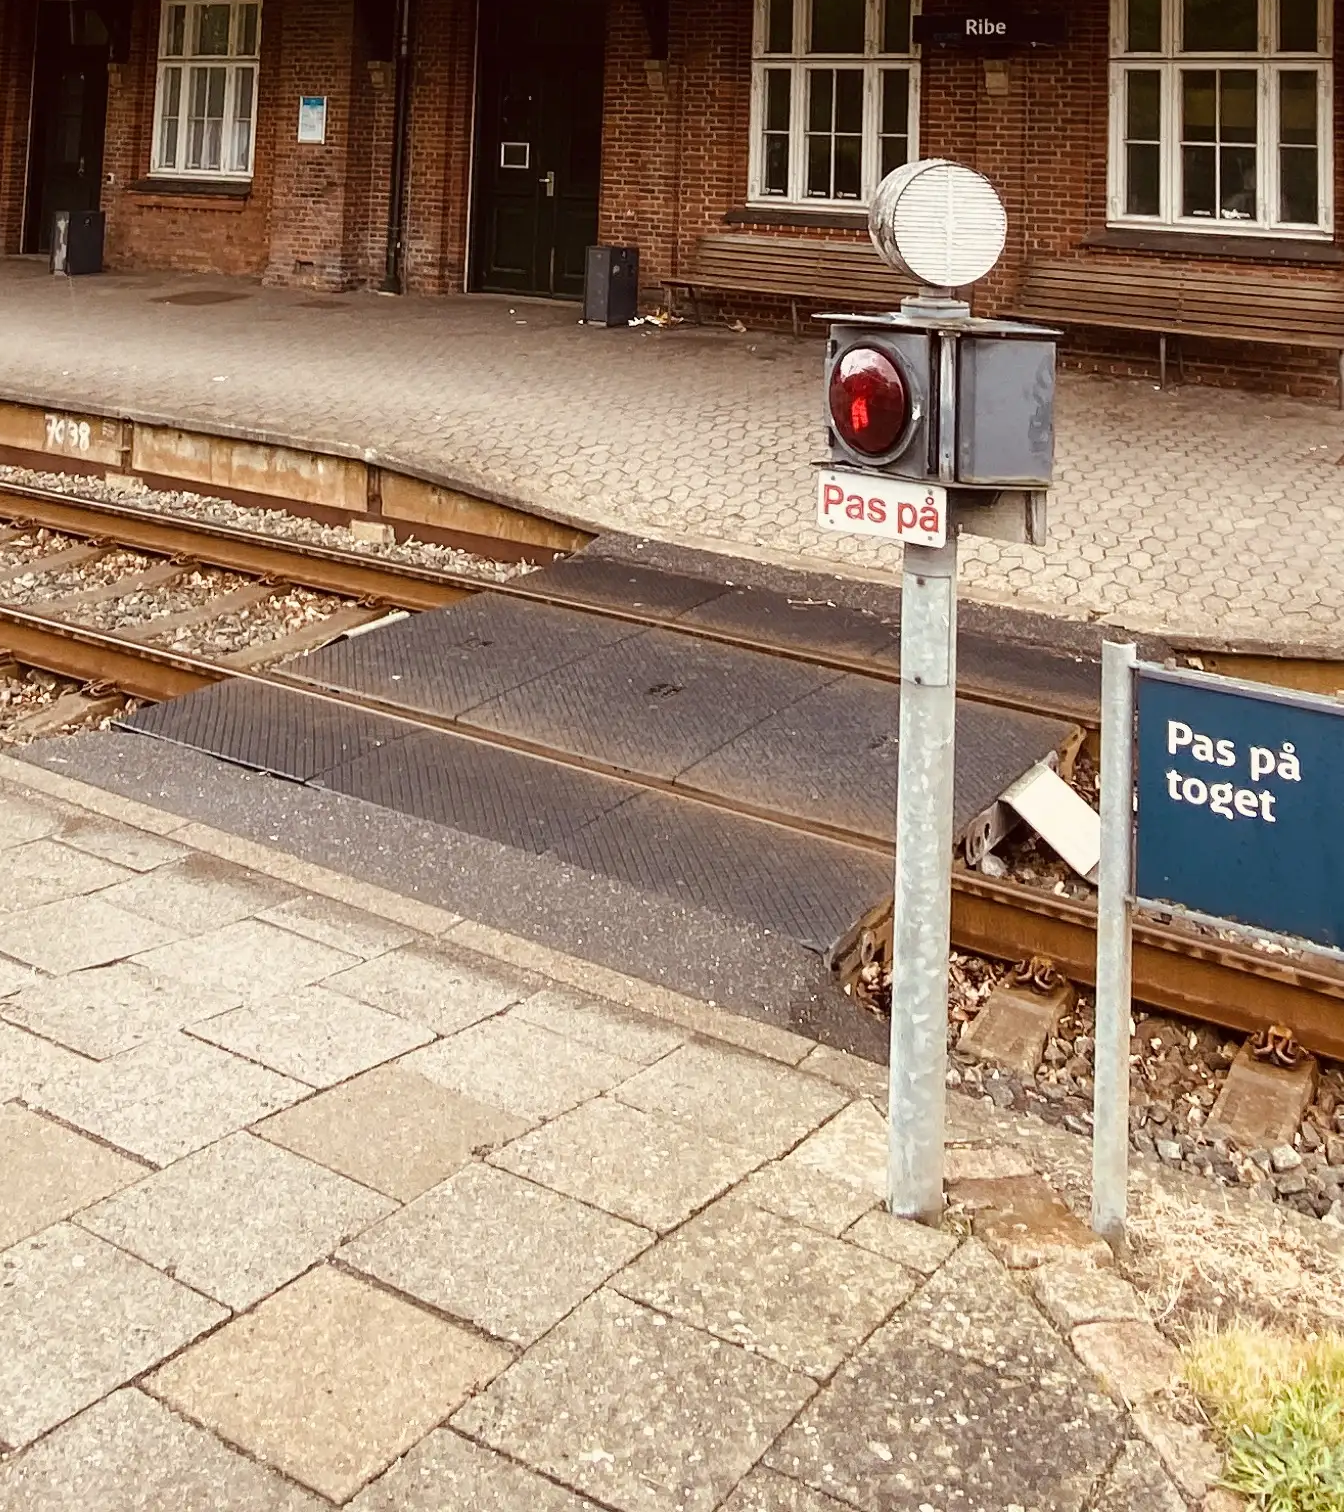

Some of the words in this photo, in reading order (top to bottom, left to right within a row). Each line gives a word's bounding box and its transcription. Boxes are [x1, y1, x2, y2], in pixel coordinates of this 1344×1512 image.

[965, 17, 1007, 36] Ribe
[823, 483, 887, 524] Pas
[896, 495, 940, 534] på
[1166, 719, 1237, 768] Pas
[1249, 741, 1302, 783] på
[1165, 768, 1277, 824] toget
